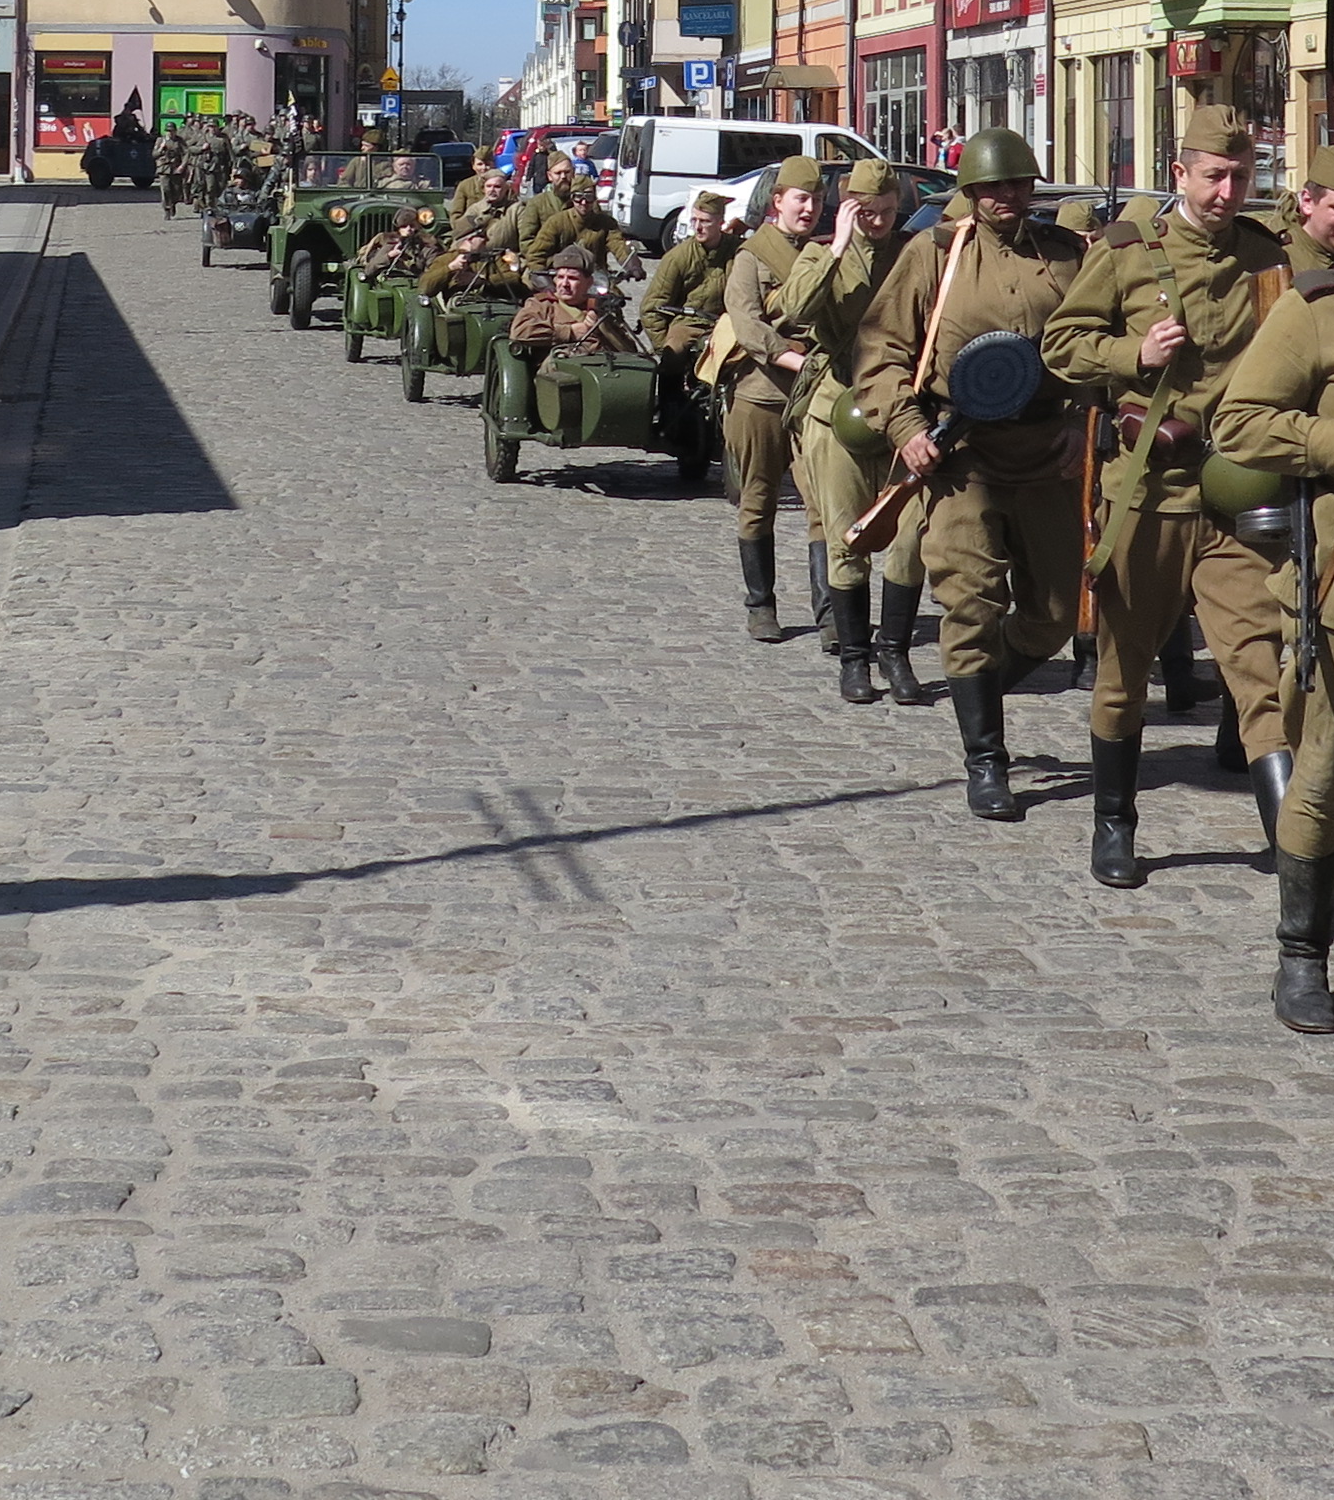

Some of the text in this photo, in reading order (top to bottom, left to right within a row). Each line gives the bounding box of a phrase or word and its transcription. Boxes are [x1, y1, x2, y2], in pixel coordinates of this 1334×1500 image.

[683, 10, 731, 21] KANCELARIA
[691, 62, 709, 87] P
[386, 98, 396, 110] P
